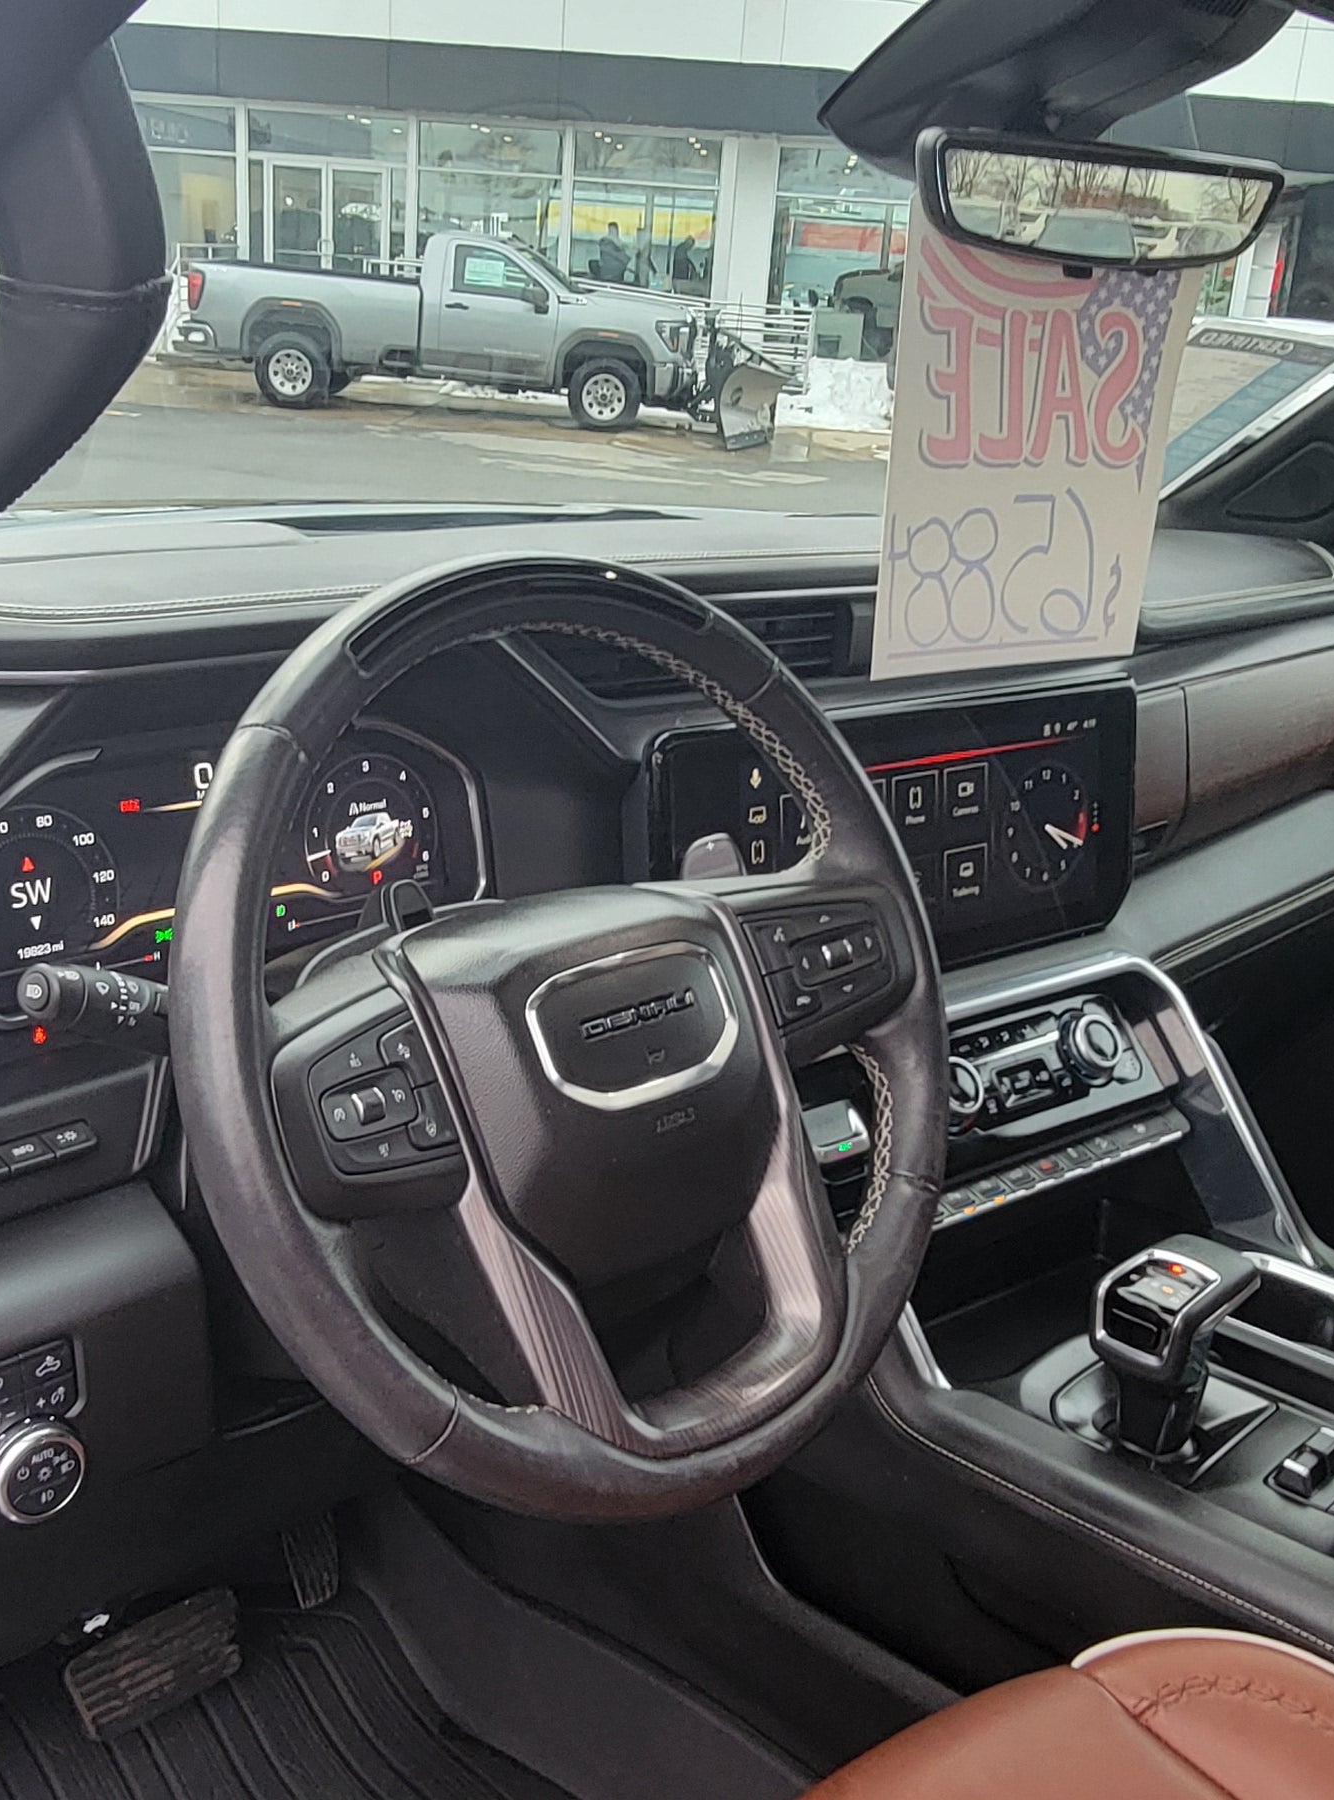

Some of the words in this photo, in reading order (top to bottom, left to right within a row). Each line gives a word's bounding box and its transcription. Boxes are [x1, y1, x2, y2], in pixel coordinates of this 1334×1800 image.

[36, 815, 53, 828] 80
[73, 833, 95, 847] 100
[93, 869, 115, 883] 120
[10, 877, 52, 909] SW
[93, 914, 115, 928] 140
[52, 940, 64, 952] mi
[580, 987, 696, 1041] DENALI
[31, 1448, 55, 1465] AUTO
